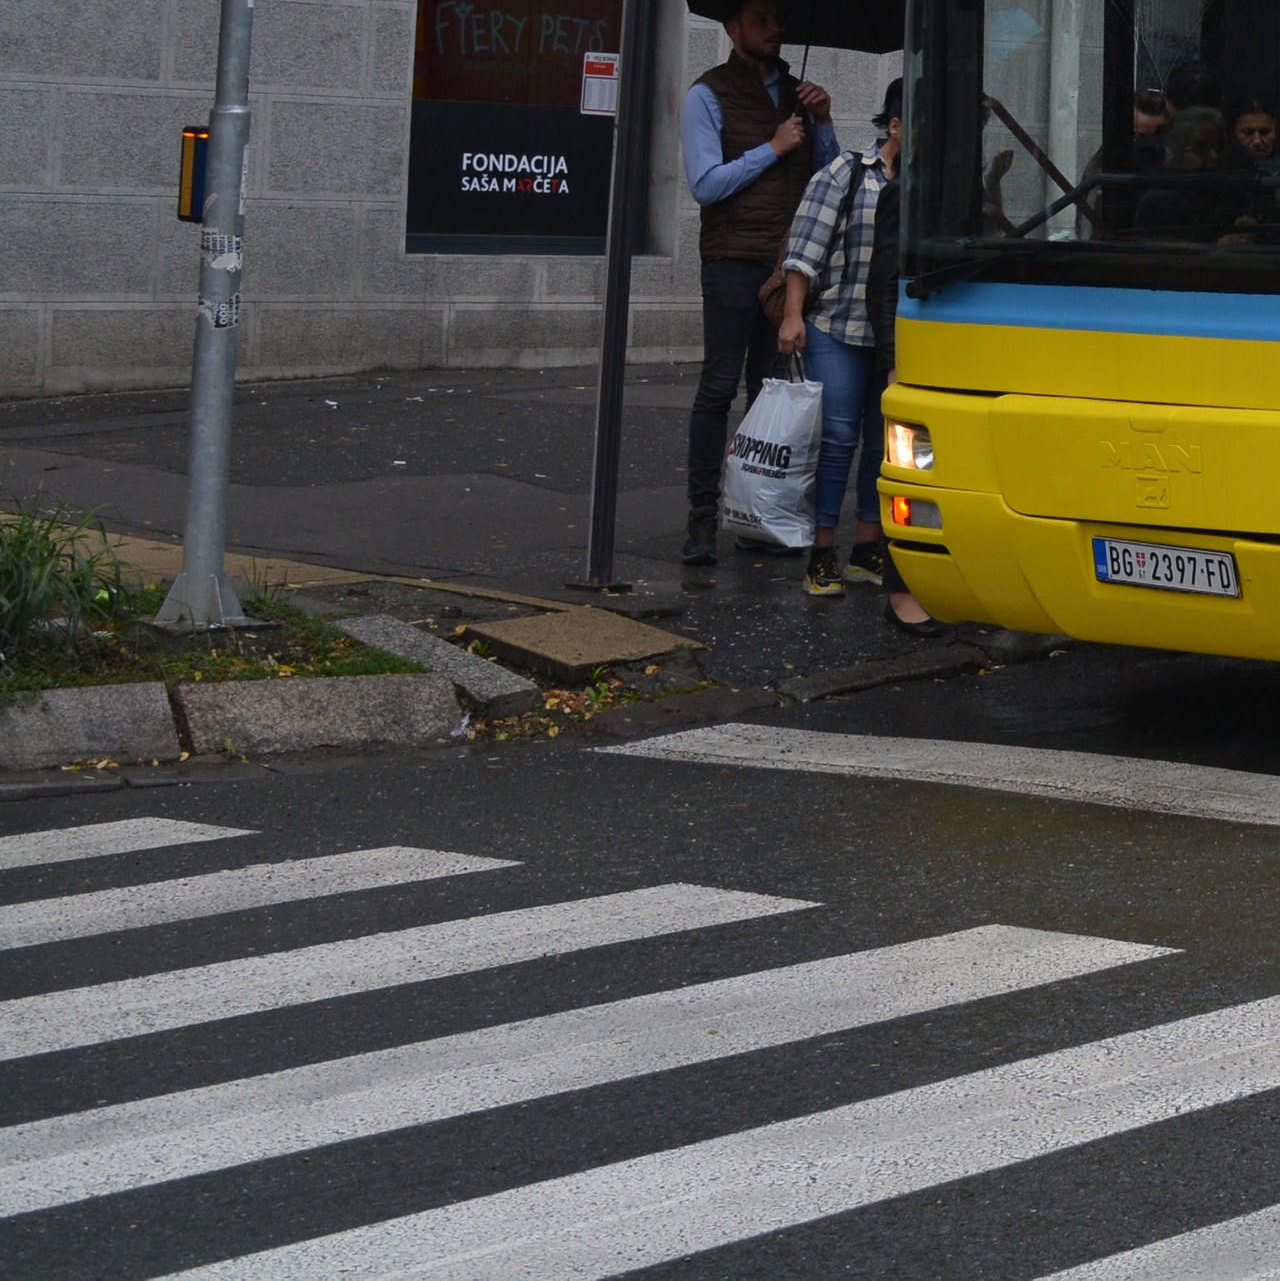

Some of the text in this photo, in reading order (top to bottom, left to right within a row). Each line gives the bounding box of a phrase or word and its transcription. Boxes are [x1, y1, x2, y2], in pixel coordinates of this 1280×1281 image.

[538, 14, 607, 56] PETS
[462, 152, 568, 178] FONDACIJA
[461, 173, 569, 194] SAŠA MARČETA
[734, 433, 791, 469] SHOPPING
[1100, 440, 1202, 474] MAN
[1109, 546, 1133, 576] BG
